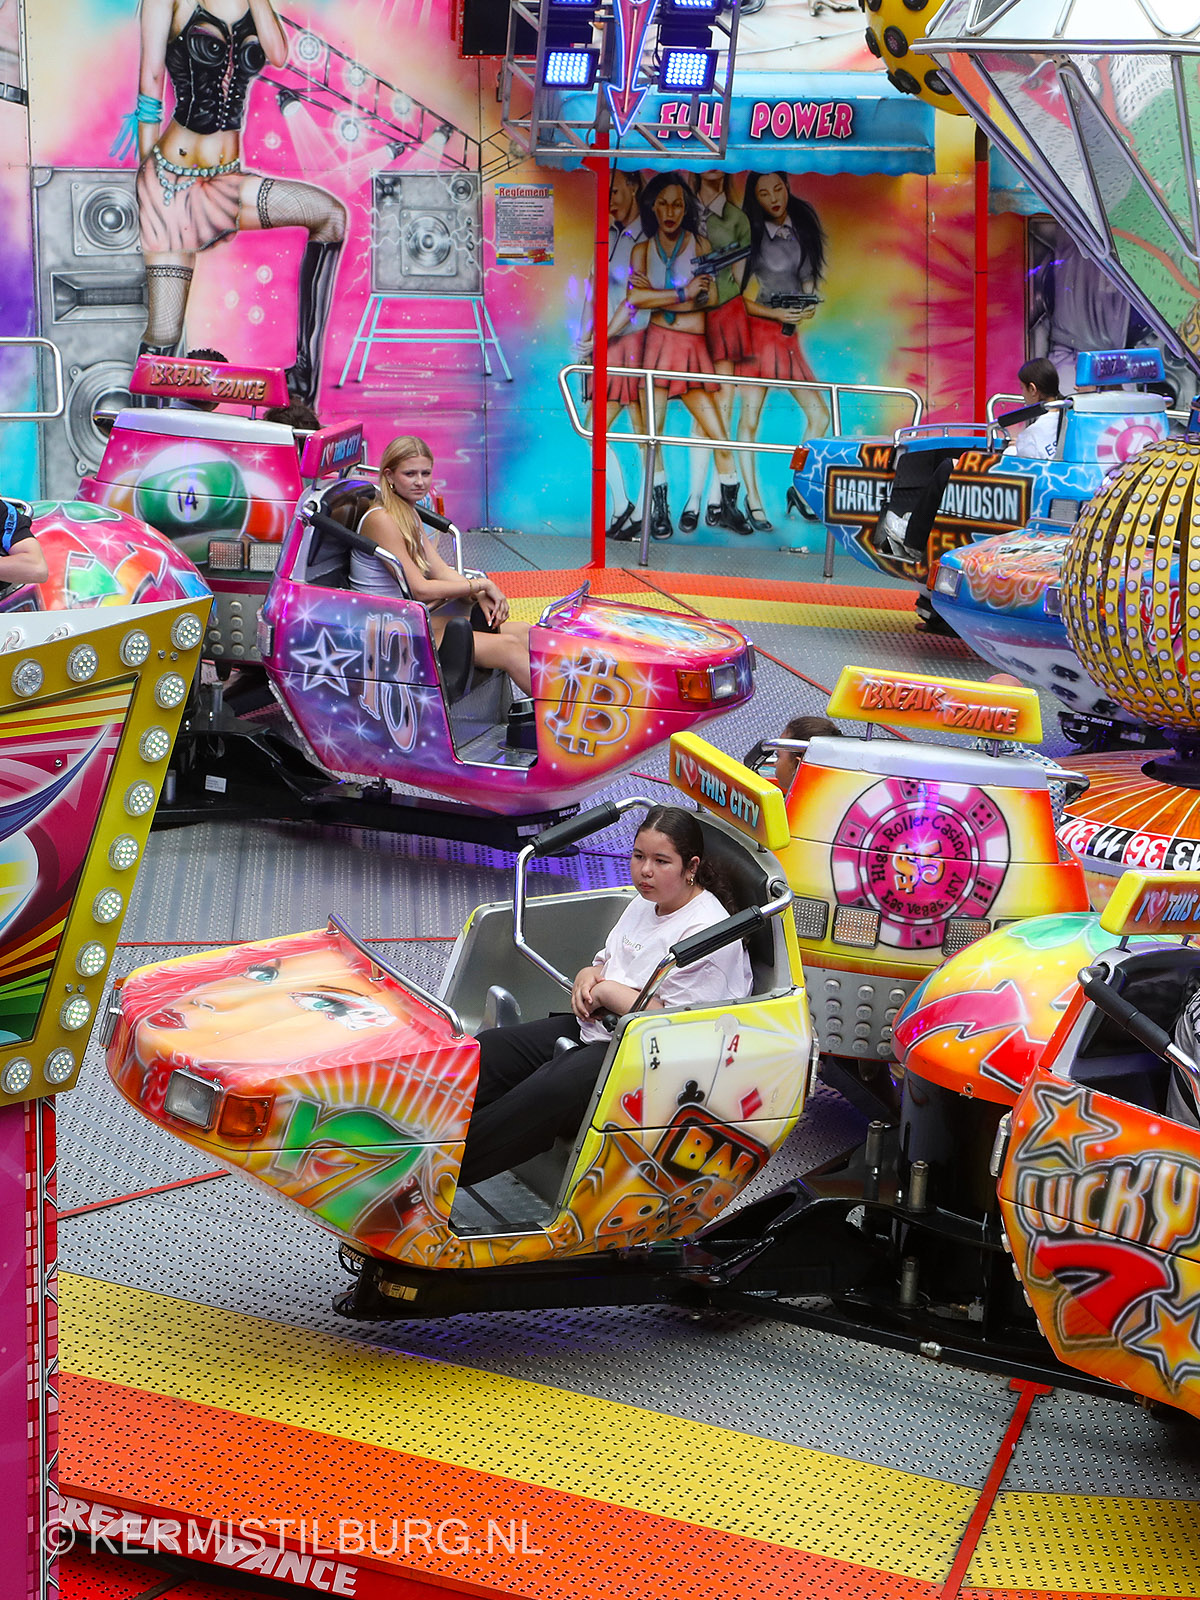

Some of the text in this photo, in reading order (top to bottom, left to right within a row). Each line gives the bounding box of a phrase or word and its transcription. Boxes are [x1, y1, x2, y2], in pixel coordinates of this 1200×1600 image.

[658, 102, 853, 139] FULL POWER
[499, 187, 549, 197] Reglement
[150, 363, 266, 400] BREAK DANCE
[177, 486, 199, 512] 14
[861, 678, 1020, 735] BREAK DANCE
[699, 770, 728, 807] THIS
[729, 788, 760, 827] CITY
[883, 814, 929, 842] Roller
[931, 814, 968, 861] Casino
[1093, 828, 1128, 858] 11
[1127, 835, 1168, 868] 36
[881, 890, 904, 912] Las
[1162, 893, 1199, 922] THIS
[650, 1036, 660, 1054] A
[727, 1034, 740, 1053] A
[1028, 1236, 1171, 1343] 7
[209, 1532, 359, 1597] DANCE
